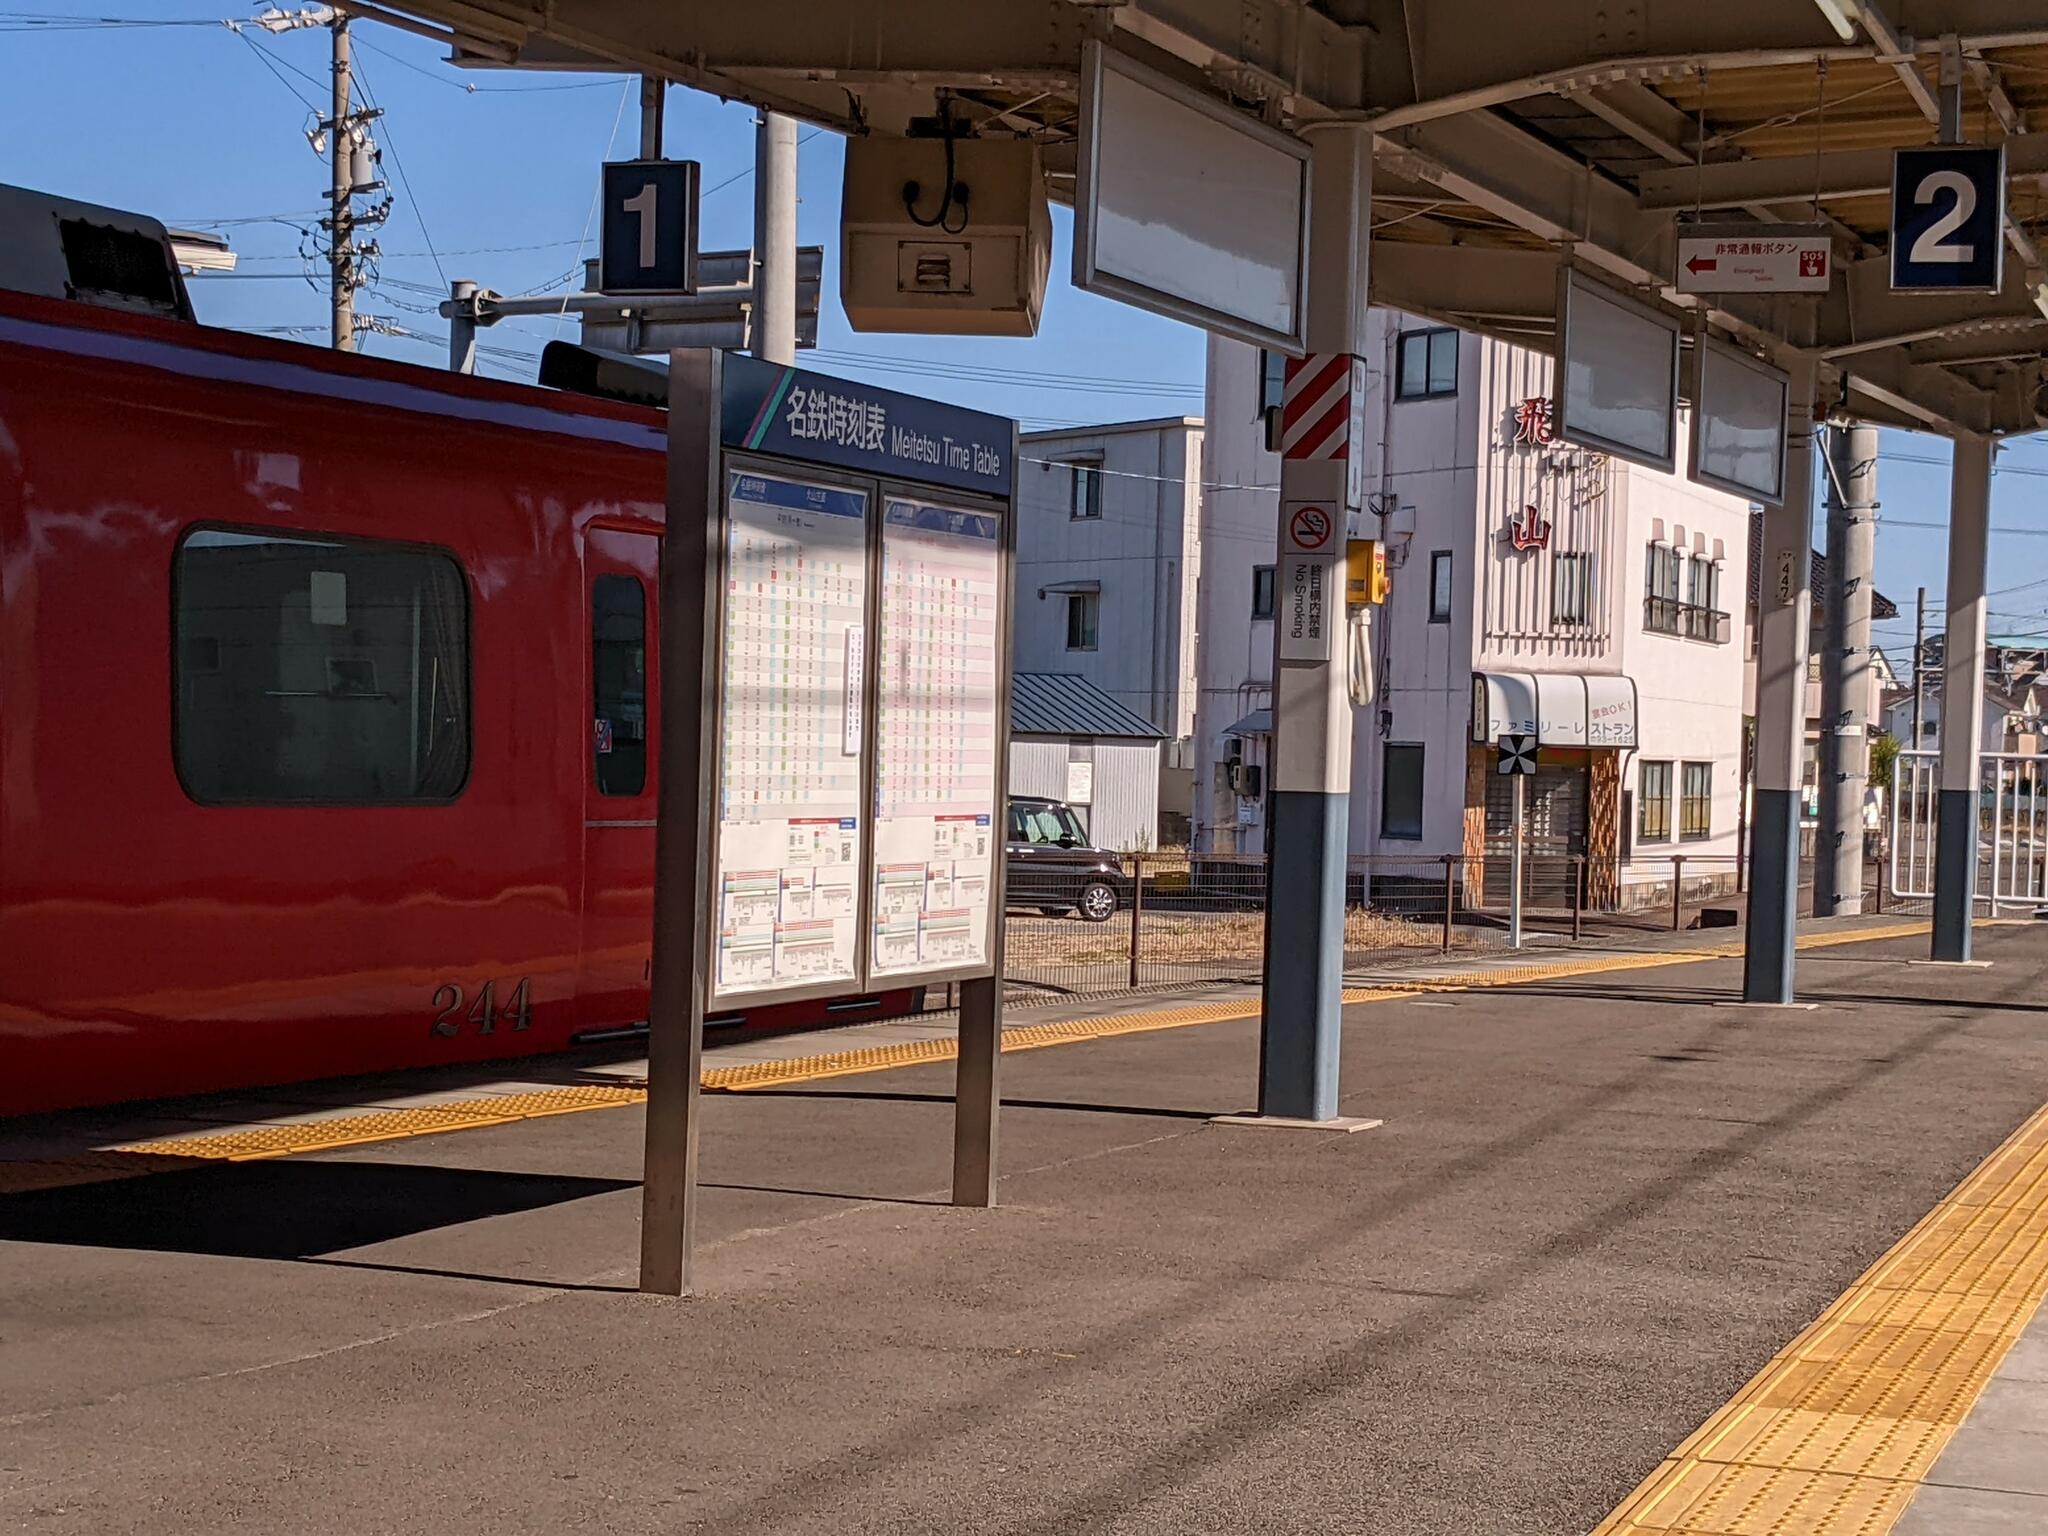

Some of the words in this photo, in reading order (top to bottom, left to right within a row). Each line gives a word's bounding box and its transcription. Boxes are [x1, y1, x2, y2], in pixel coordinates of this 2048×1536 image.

[623, 184, 657, 268] 1
[1909, 170, 1977, 263] 2
[1715, 243, 1798, 256] 非常通報ボタン
[1802, 252, 1823, 262] SOS
[786, 386, 886, 454] 名鉄時刻表
[891, 425, 941, 465] Meitetsu
[943, 437, 970, 472] Time
[972, 443, 1001, 478] Table
[1296, 564, 1307, 582] No
[1780, 562, 1790, 598] 447
[1291, 585, 1307, 639] Smoking
[431, 976, 532, 1037] 244
